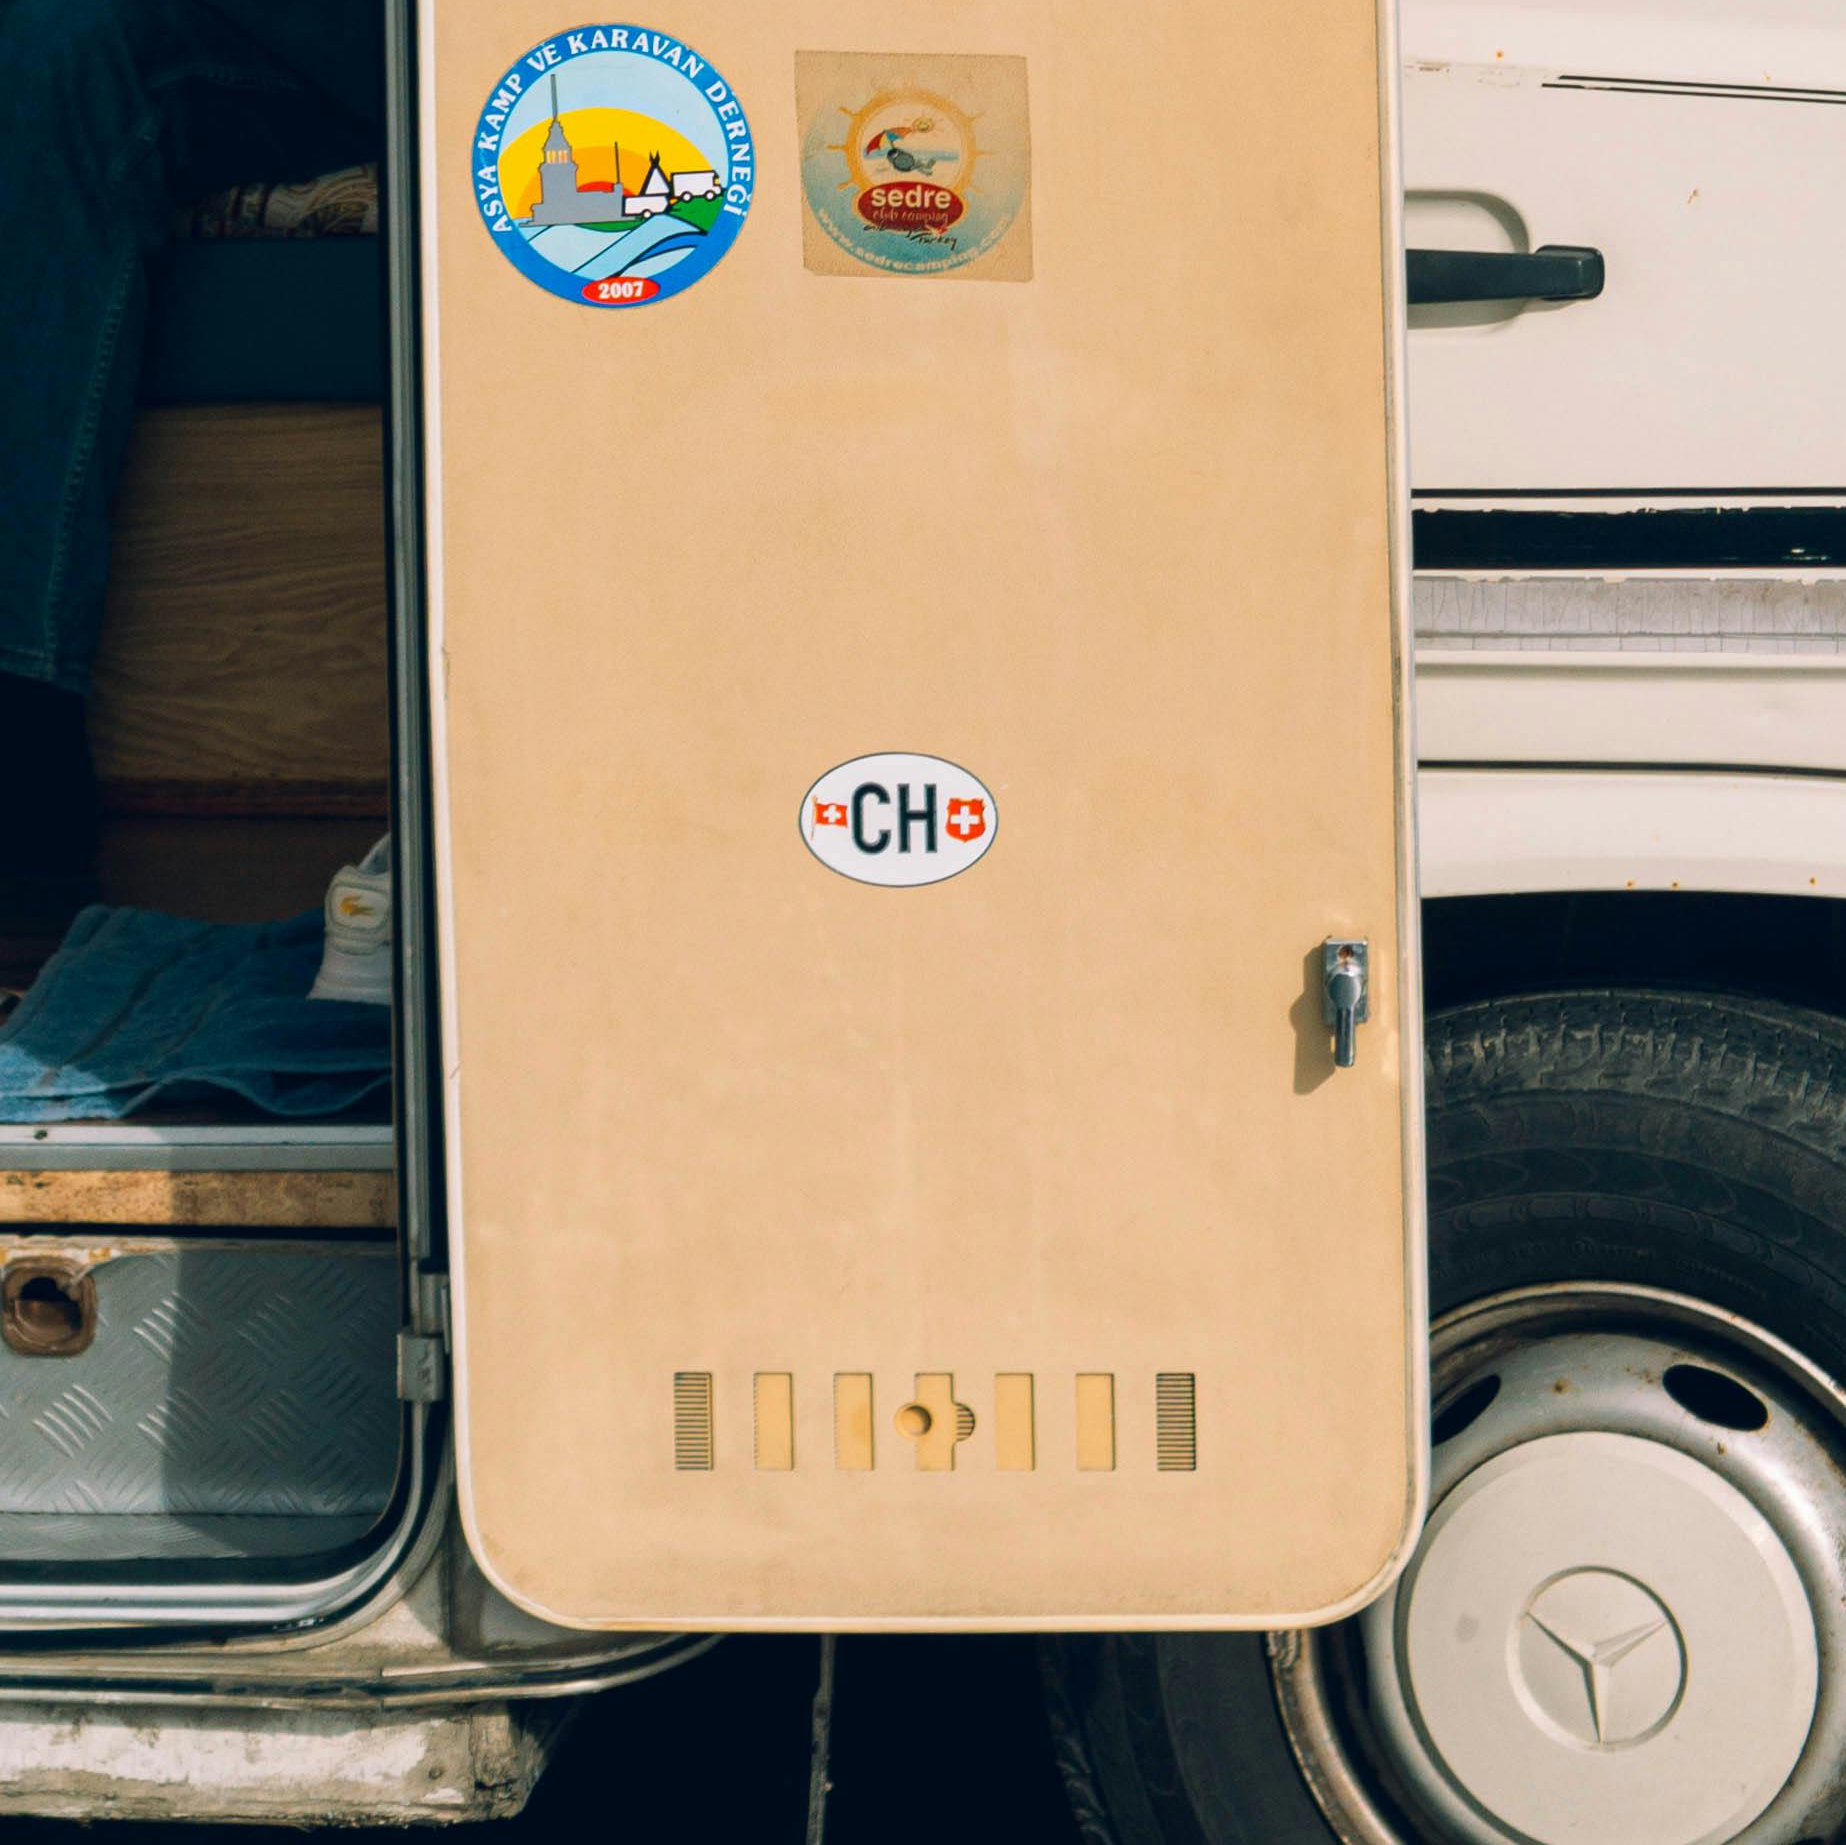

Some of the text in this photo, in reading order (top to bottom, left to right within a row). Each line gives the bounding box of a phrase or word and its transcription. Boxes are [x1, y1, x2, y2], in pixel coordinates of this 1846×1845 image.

[526, 43, 563, 72] VE
[567, 28, 705, 79] KARAVAN
[477, 72, 524, 152] KAMP
[478, 164, 513, 233] ASYA
[870, 184, 952, 209] sedre
[597, 280, 645, 299] 2007
[851, 781, 938, 855] CH
